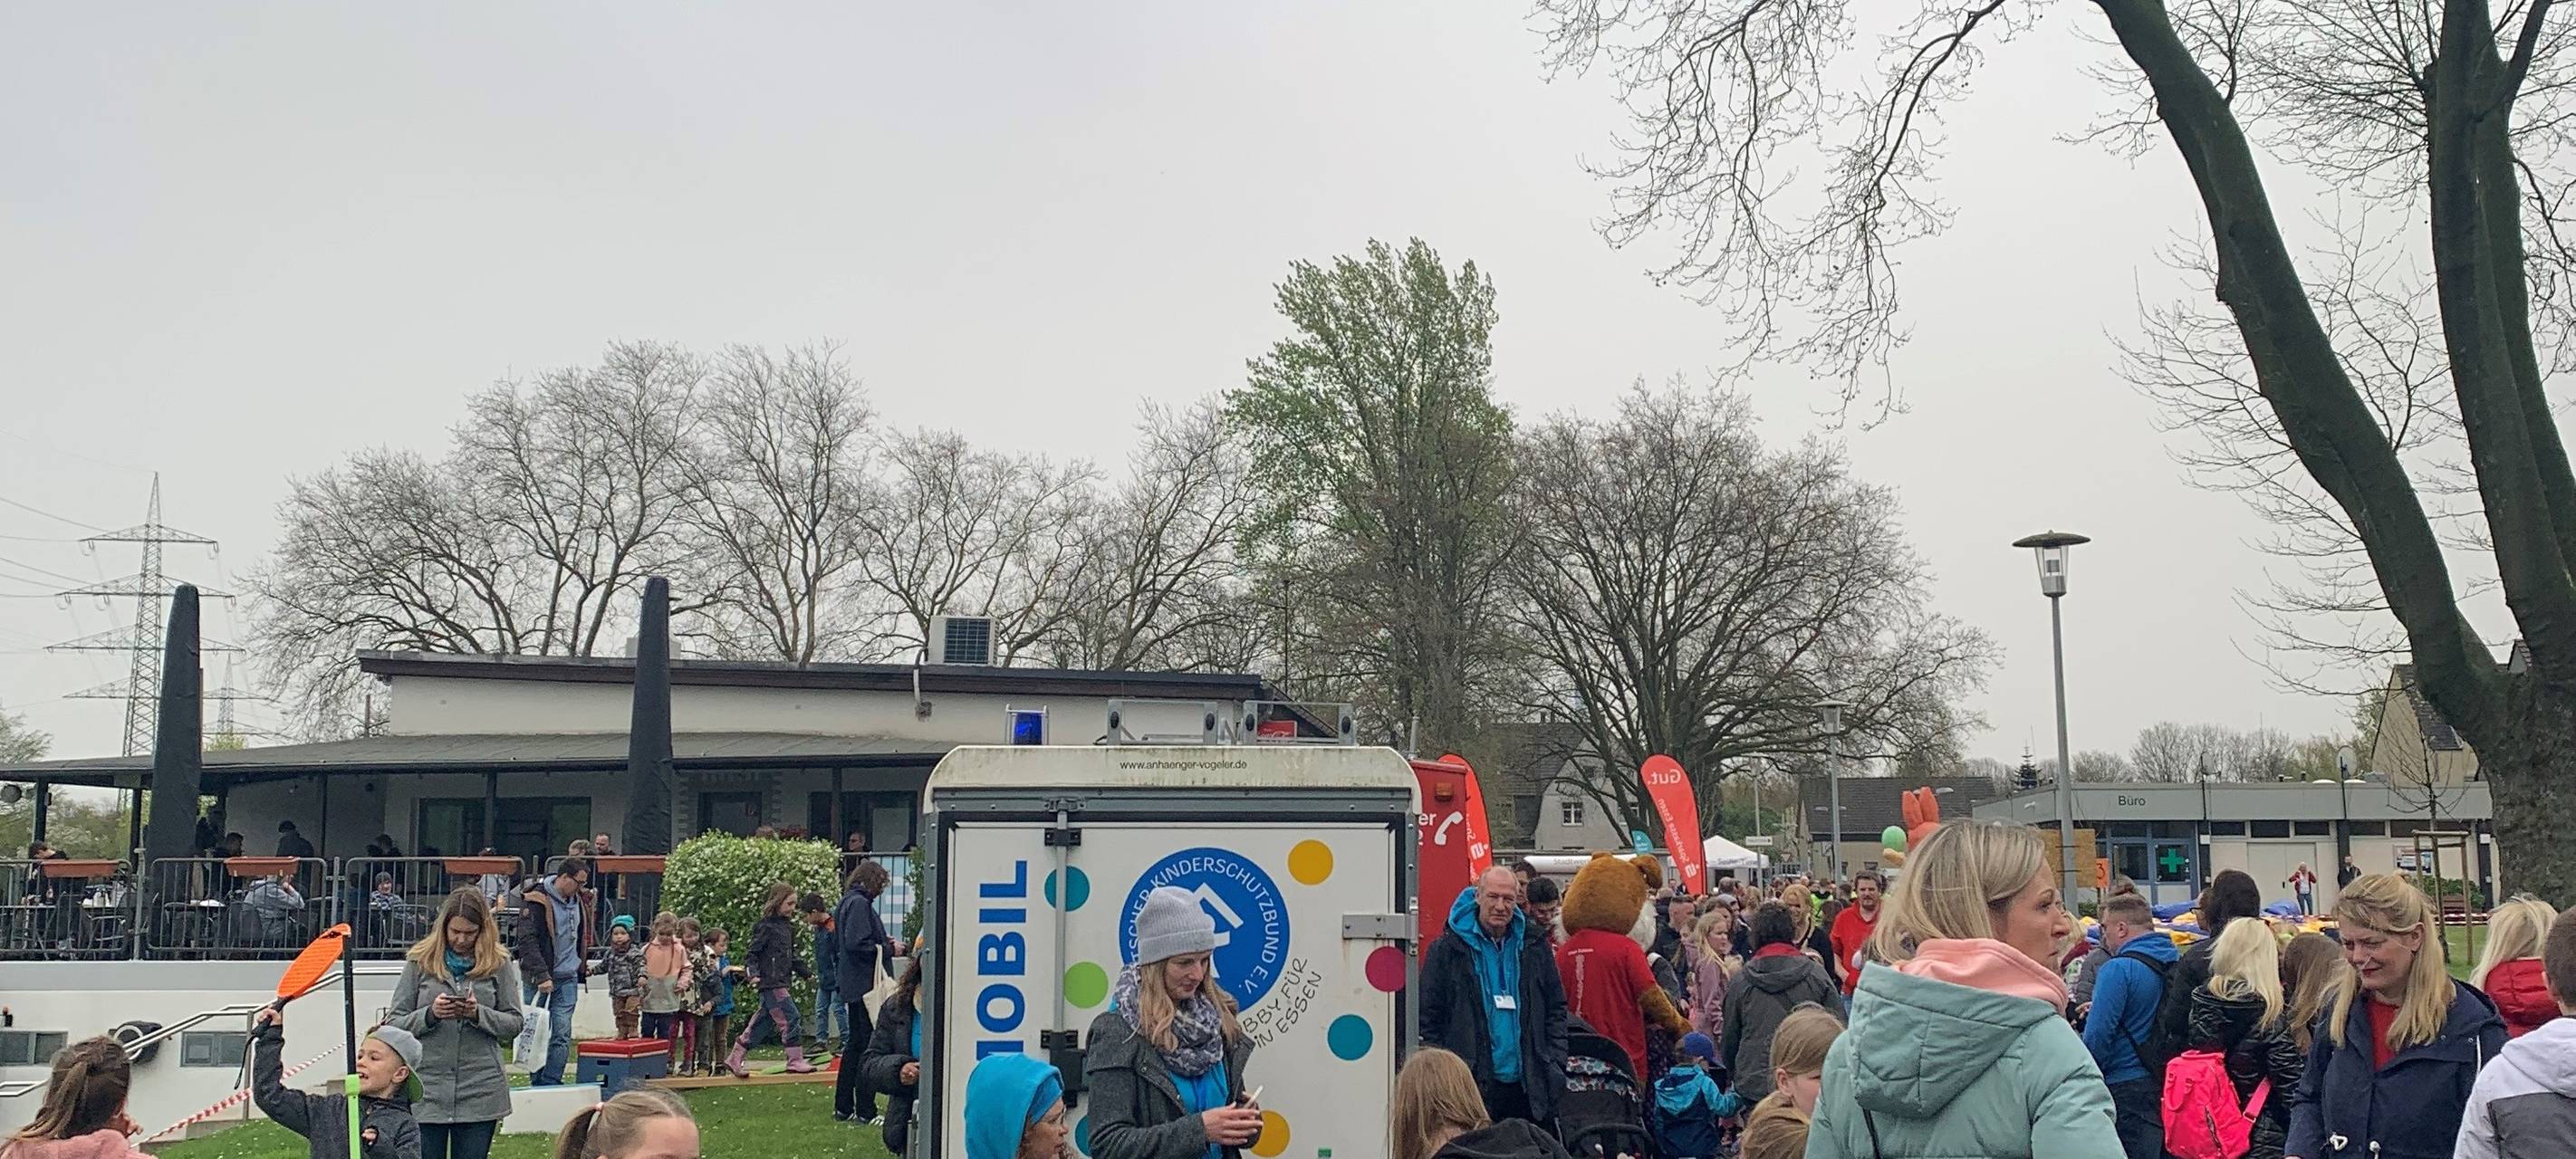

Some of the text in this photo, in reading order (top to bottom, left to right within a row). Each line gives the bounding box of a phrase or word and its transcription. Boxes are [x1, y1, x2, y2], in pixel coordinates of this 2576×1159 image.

[1120, 760, 1247, 770] www.anhaenger-vogeler.de
[1418, 813, 1437, 826] er
[2118, 795, 2146, 806] Büro
[1150, 857, 1280, 963] KINDERSCHUTZBUND
[1243, 958, 1308, 1034] BBY FÜR
[1275, 971, 1322, 1034] ESSEN
